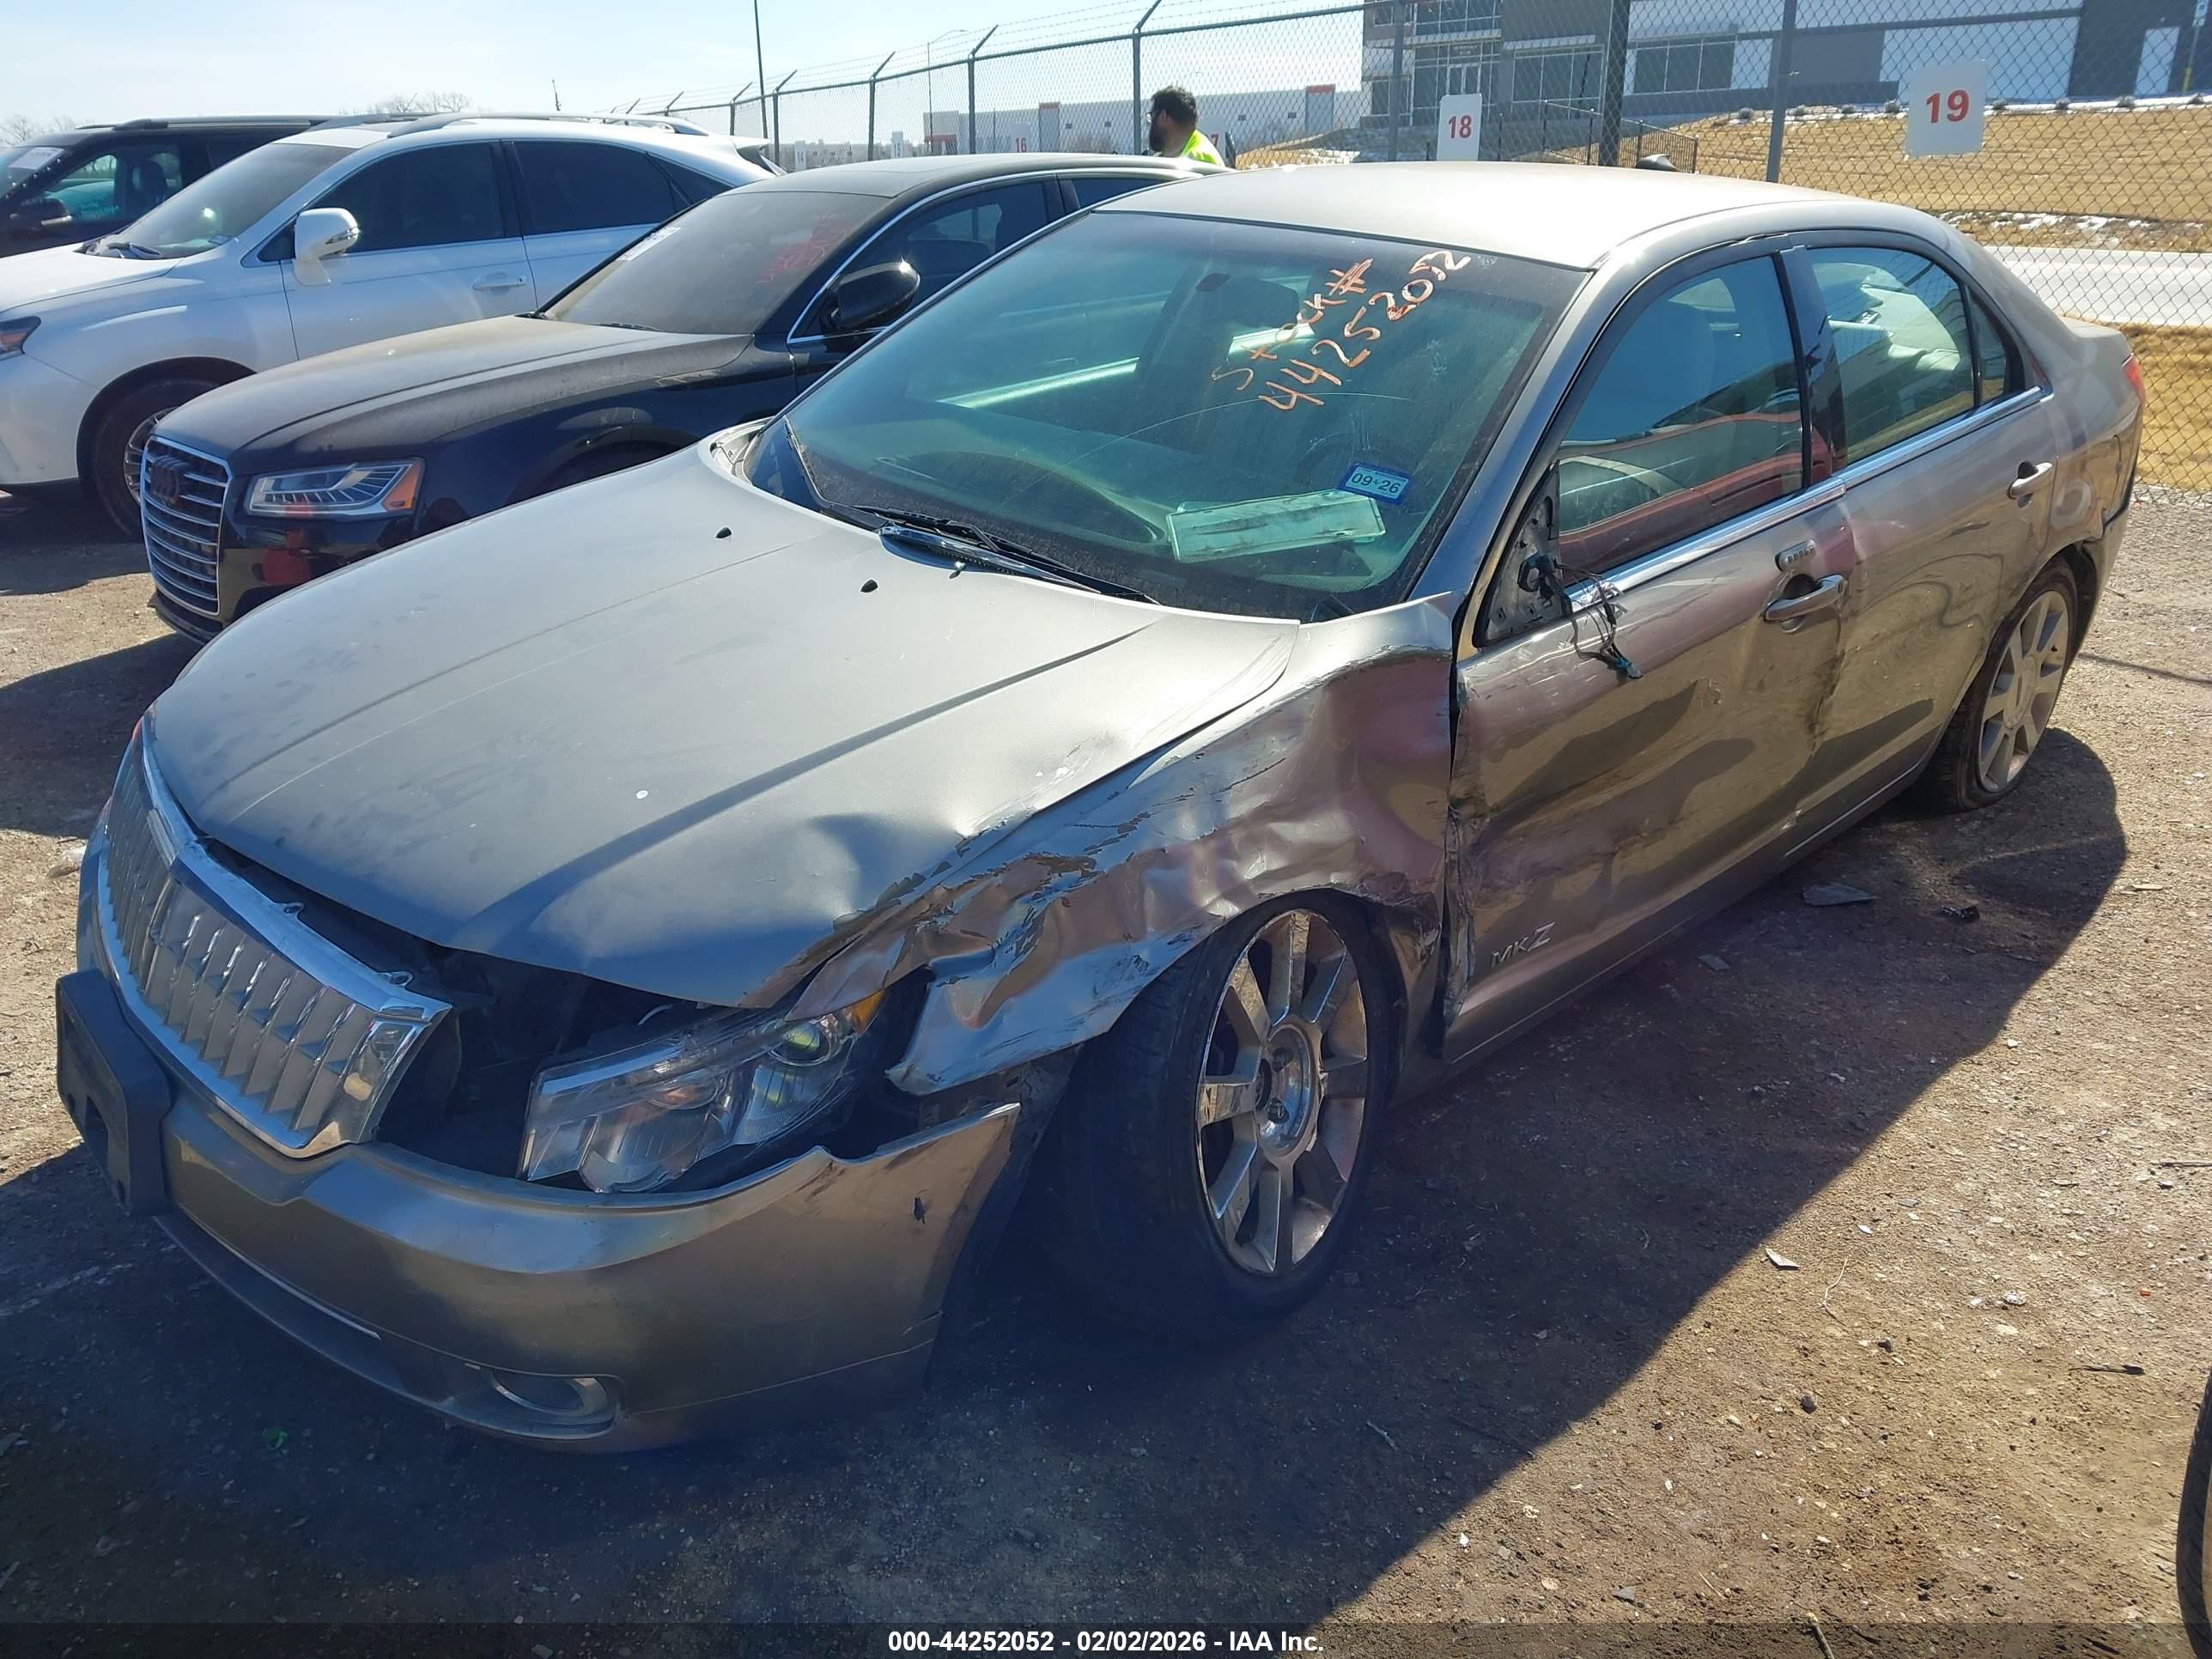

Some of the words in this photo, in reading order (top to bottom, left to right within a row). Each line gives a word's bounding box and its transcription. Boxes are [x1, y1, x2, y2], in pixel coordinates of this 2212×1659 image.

[1926, 89, 1970, 124] 19
[1449, 114, 1472, 138] 18
[1015, 137, 1027, 153] 16
[1258, 251, 1471, 410] 44252052
[1490, 921, 1556, 969] MKZ
